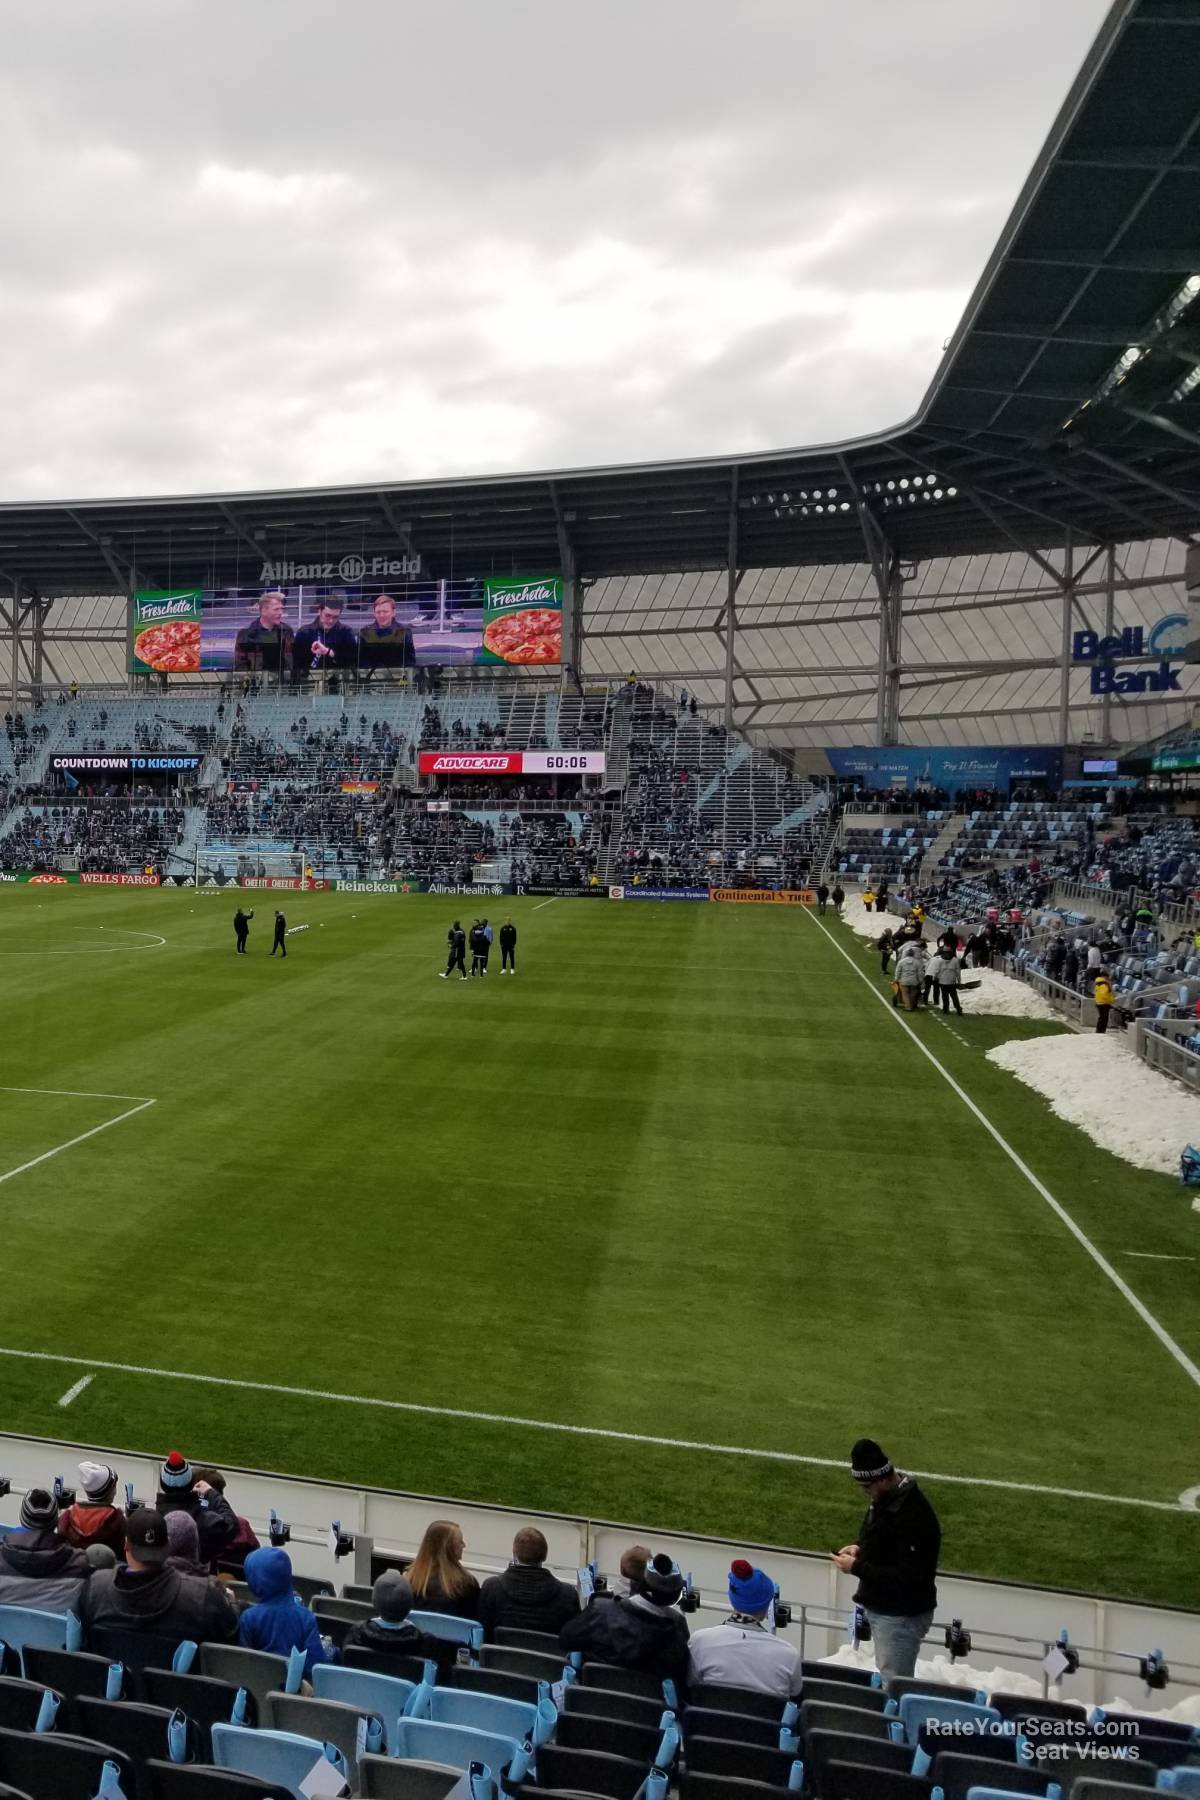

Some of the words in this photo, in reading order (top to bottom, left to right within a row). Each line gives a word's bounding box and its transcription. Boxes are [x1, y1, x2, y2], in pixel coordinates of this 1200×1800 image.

[259, 561, 334, 581] Allianz
[372, 554, 421, 576] Field
[491, 585, 553, 607] Freschetta
[140, 599, 193, 619] Freschetta
[1073, 626, 1143, 660] Bell
[1090, 660, 1183, 695] Bank
[54, 758, 128, 769] COUNTDOWN
[130, 758, 146, 769] TO
[147, 758, 198, 769] KICKOFF
[434, 757, 509, 770] ADVOCARE
[546, 756, 587, 769] 60:06
[81, 874, 118, 885] WELLS
[121, 874, 158, 886] FARGO
[336, 880, 398, 892] Heineken
[428, 884, 456, 895] Allina
[457, 884, 490, 895] Health
[713, 890, 775, 902] Continental
[788, 894, 812, 902] TIRE
